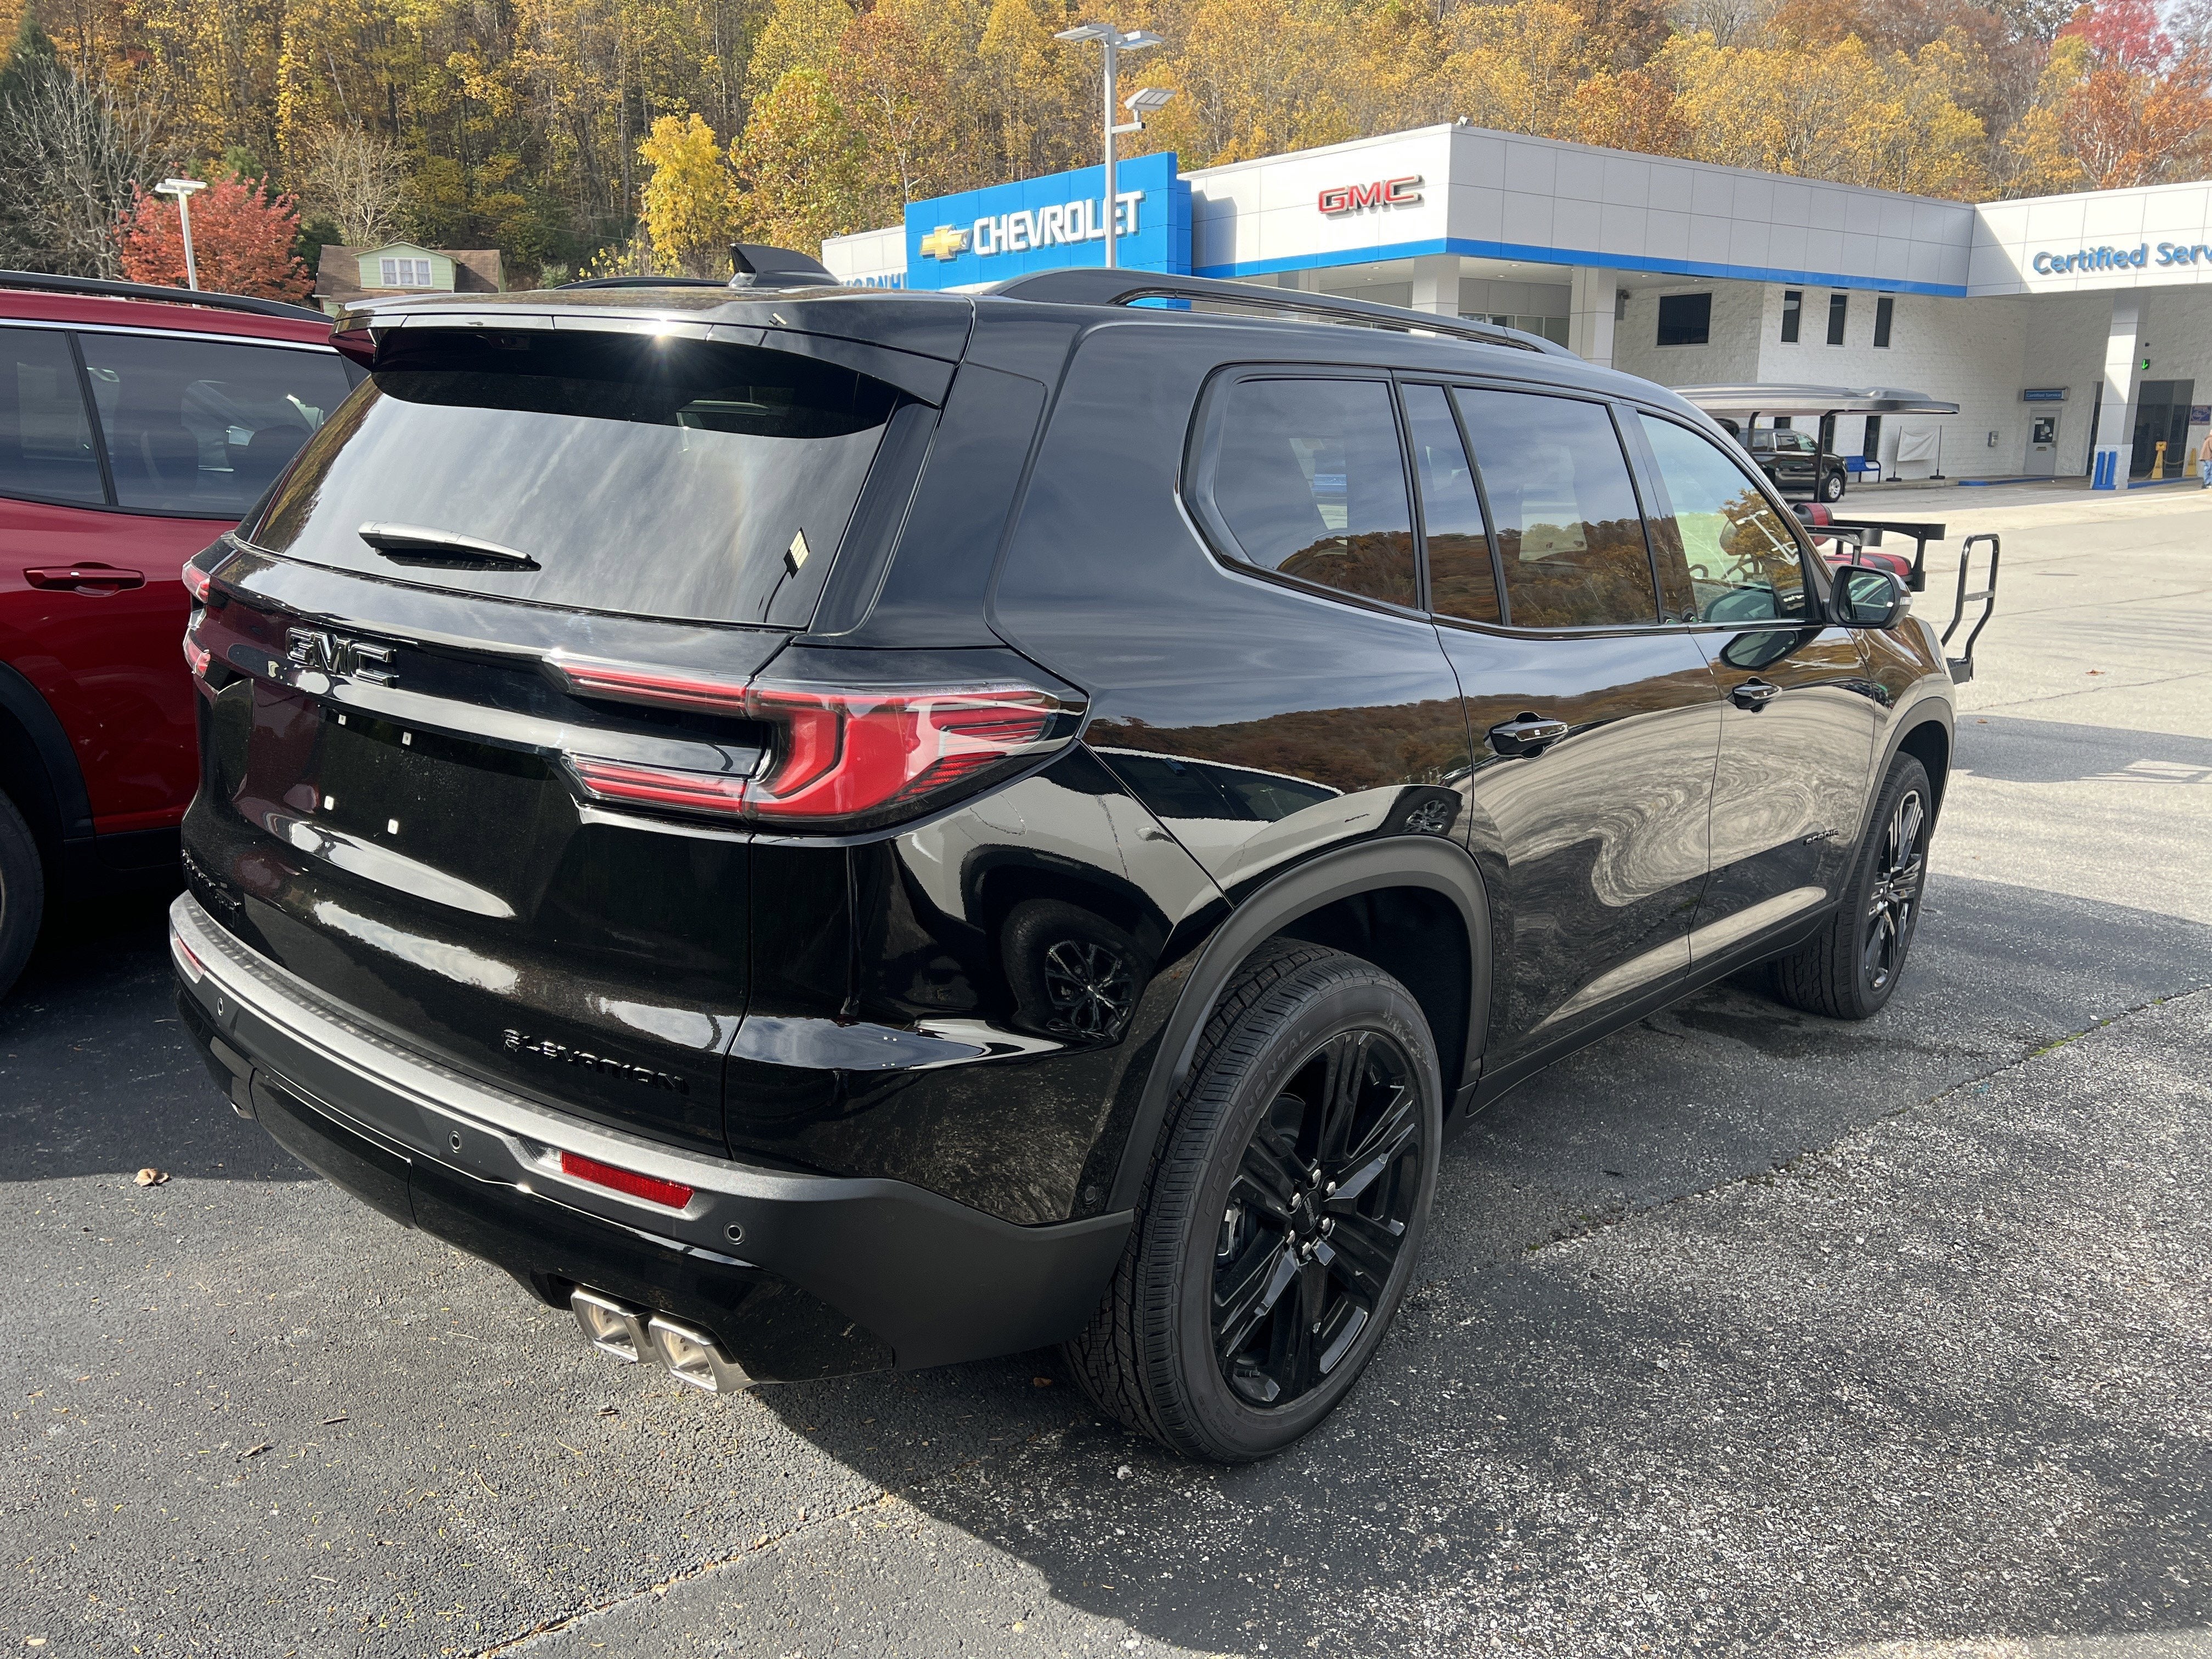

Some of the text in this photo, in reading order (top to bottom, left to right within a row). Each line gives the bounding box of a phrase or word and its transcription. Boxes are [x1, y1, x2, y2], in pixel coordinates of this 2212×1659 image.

[974, 190, 1146, 256] CHEVROLET
[1318, 174, 1423, 215] GMC
[2033, 242, 2212, 275] Certified Serv
[286, 627, 398, 687] GMC
[503, 1029, 689, 1094] ELEVATION
[1205, 1026, 1312, 1217] CONTINENTAL
